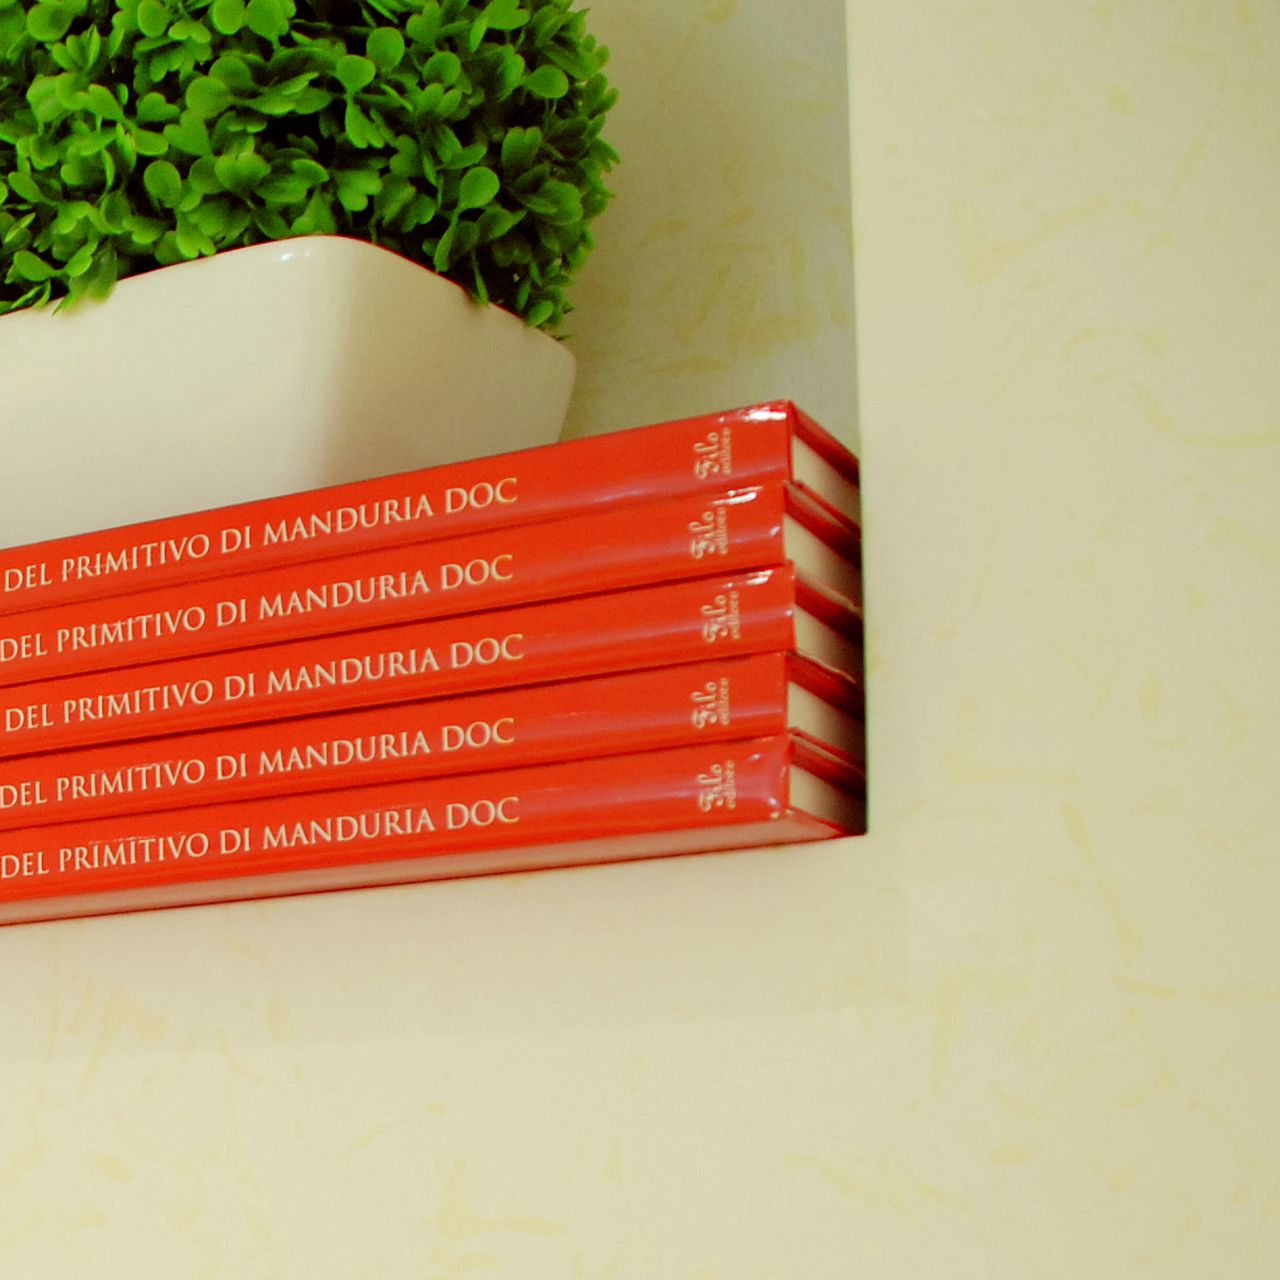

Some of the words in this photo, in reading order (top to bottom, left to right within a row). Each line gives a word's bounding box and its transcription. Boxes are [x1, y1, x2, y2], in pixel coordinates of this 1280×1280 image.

[3, 562, 53, 593] DEL
[59, 533, 211, 583] PRIMITIVO
[220, 524, 252, 555] DI
[261, 493, 434, 547] MANDURIA
[444, 476, 519, 512] DOC
[55, 605, 207, 653] PRIMITIVO
[215, 599, 248, 627] DI
[257, 568, 431, 620] MANDURIA
[439, 552, 515, 591] DOC
[4, 702, 55, 732] DEL
[62, 678, 215, 724] PRIMITIVO
[224, 673, 257, 701] DI
[265, 648, 440, 696] MANDURIA
[449, 632, 526, 669] DOC
[55, 758, 207, 802] PRIMITIVO
[215, 752, 249, 781] DI
[257, 729, 432, 776] MANDURIA
[439, 717, 516, 751] DOC
[0, 850, 50, 879] DEL
[58, 830, 210, 872] PRIMITIVO
[219, 826, 252, 853] DI
[261, 803, 436, 851] MANDURIA
[445, 796, 521, 829] DOC
